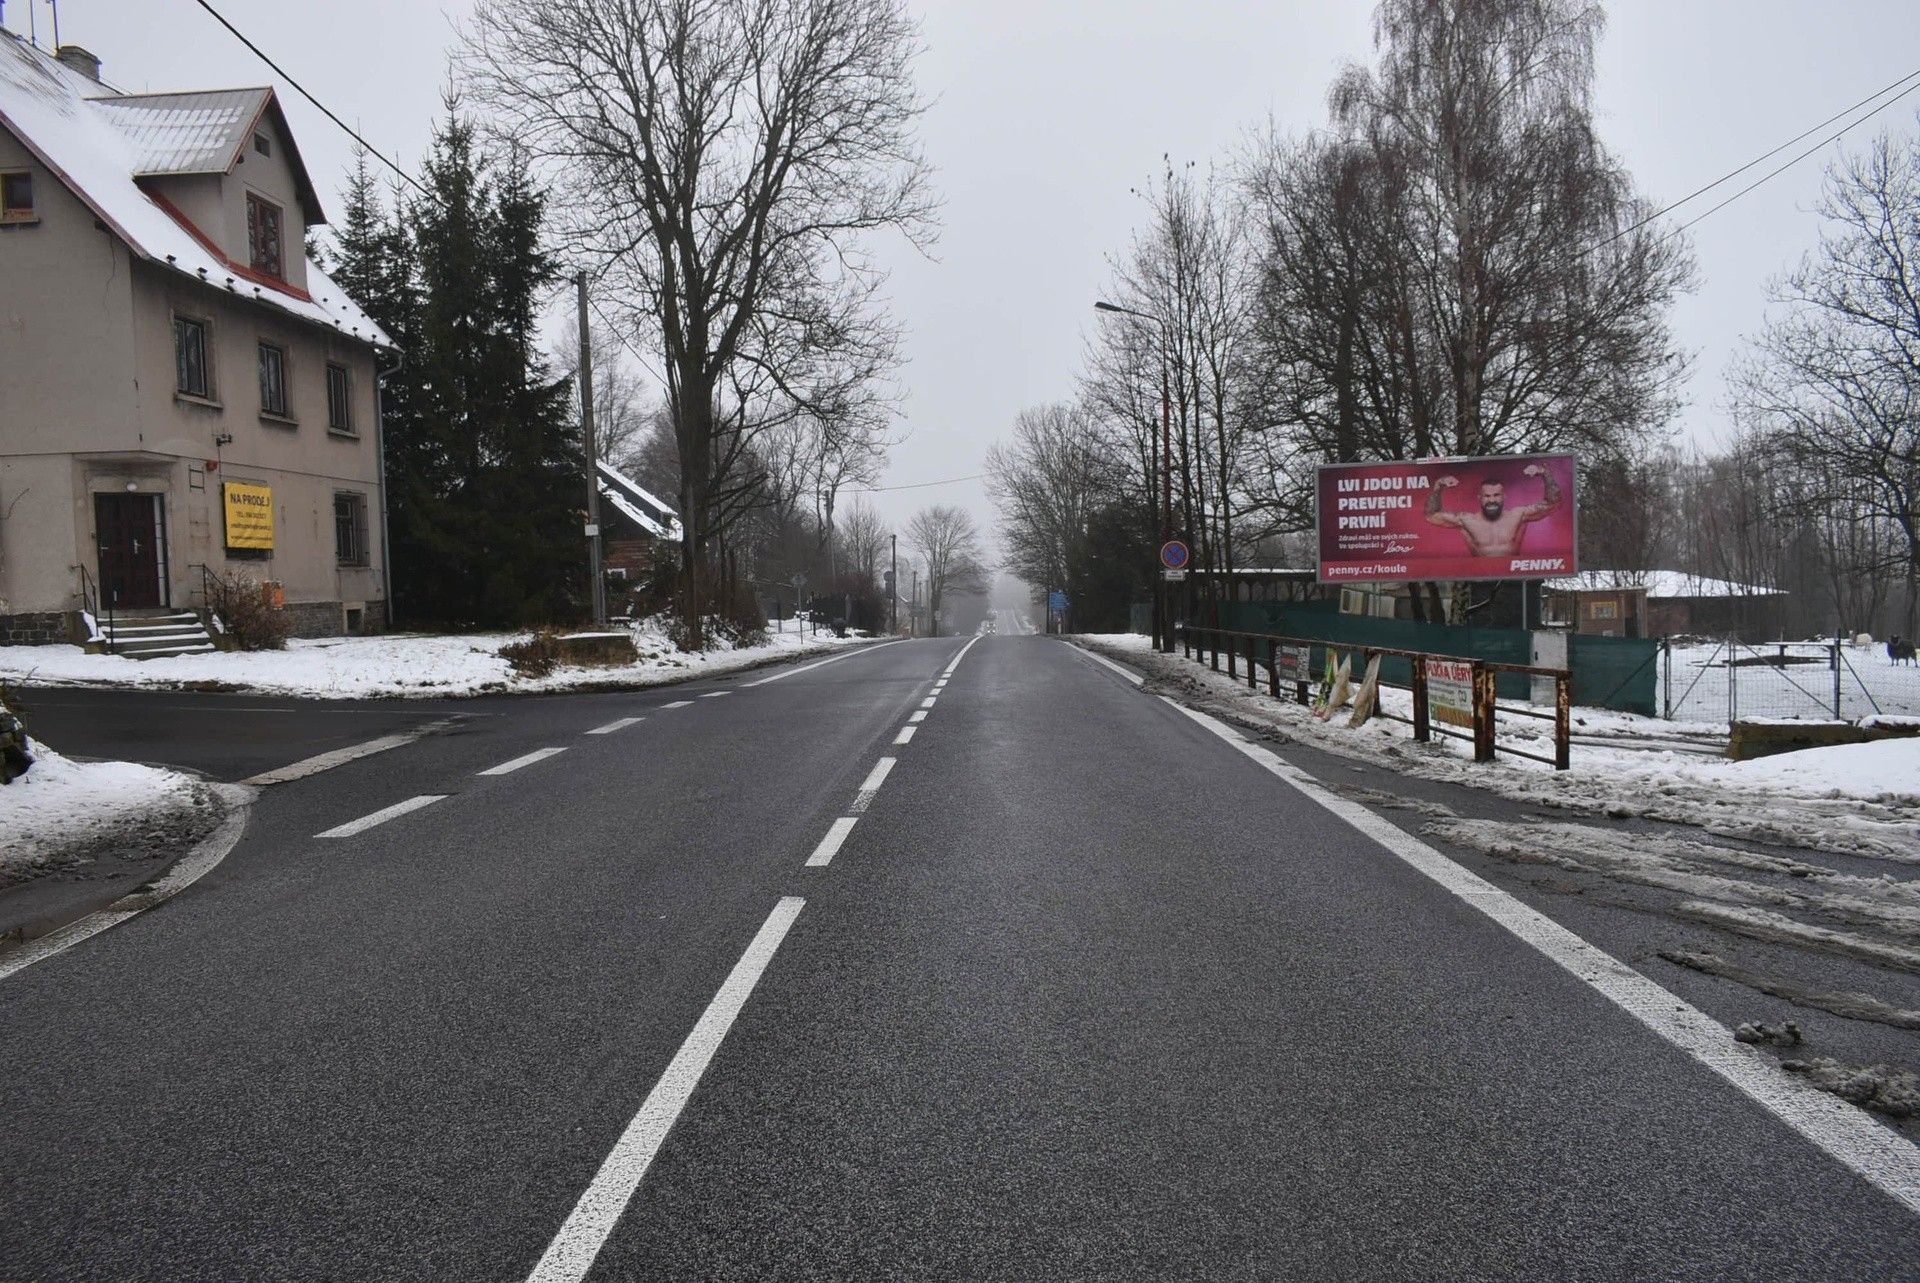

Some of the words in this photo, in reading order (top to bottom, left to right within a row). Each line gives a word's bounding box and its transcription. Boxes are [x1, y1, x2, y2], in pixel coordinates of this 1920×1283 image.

[1338, 480, 1360, 492] LVI
[1363, 478, 1403, 491] JDOU
[1407, 476, 1430, 489] NA
[230, 493, 242, 504] NA
[243, 494, 270, 507] PRODEJ
[1338, 496, 1412, 510] PREVENCI
[1338, 512, 1386, 529] PRVNÍ
[1329, 564, 1407, 576] penny.cz/koule
